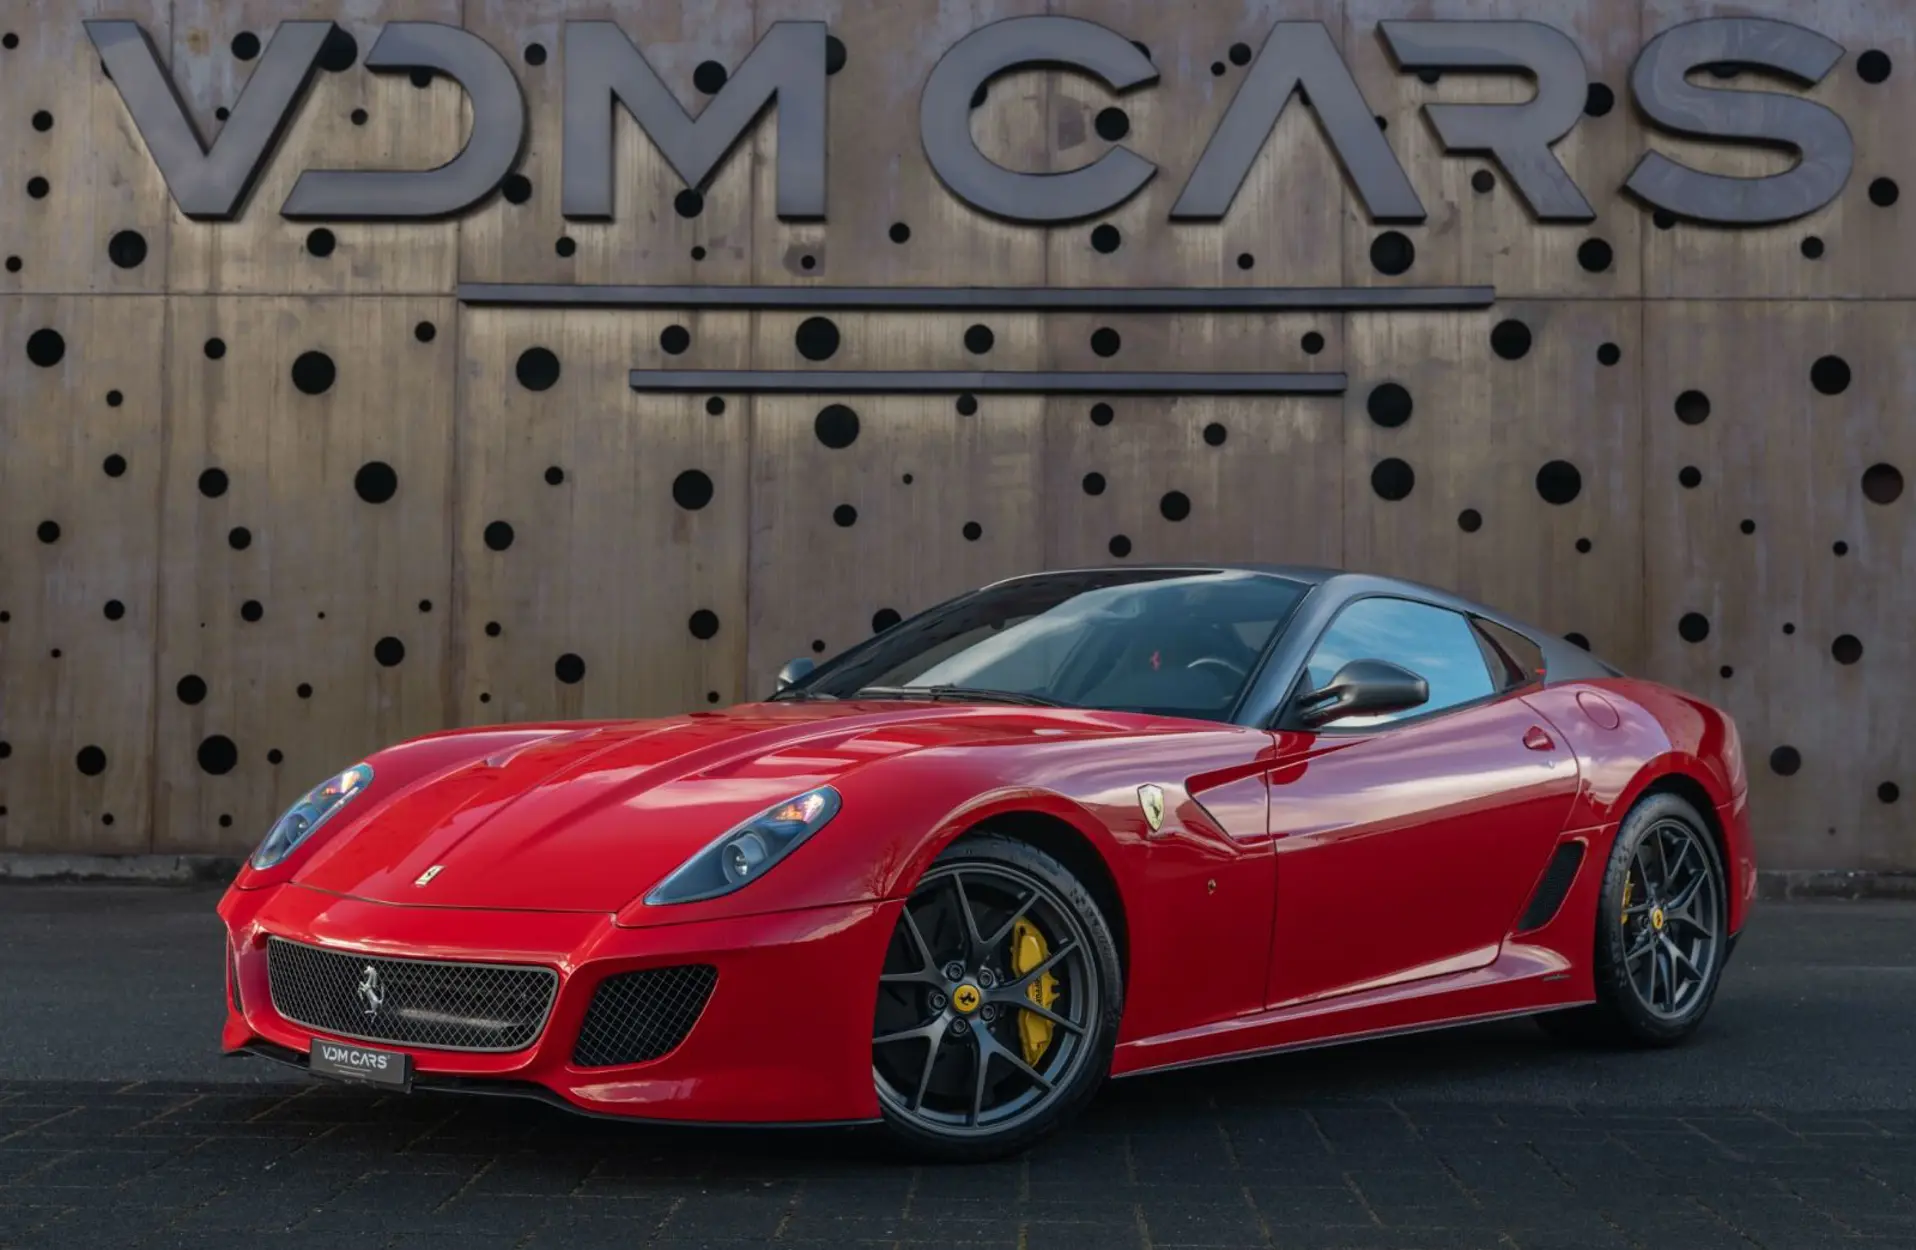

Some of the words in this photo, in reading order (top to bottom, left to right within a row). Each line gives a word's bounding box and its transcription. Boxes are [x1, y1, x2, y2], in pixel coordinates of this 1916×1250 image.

[82, 18, 828, 223] VDM
[919, 15, 1855, 228] CARS
[322, 1045, 349, 1063] VDM
[350, 1049, 388, 1069] CARS
